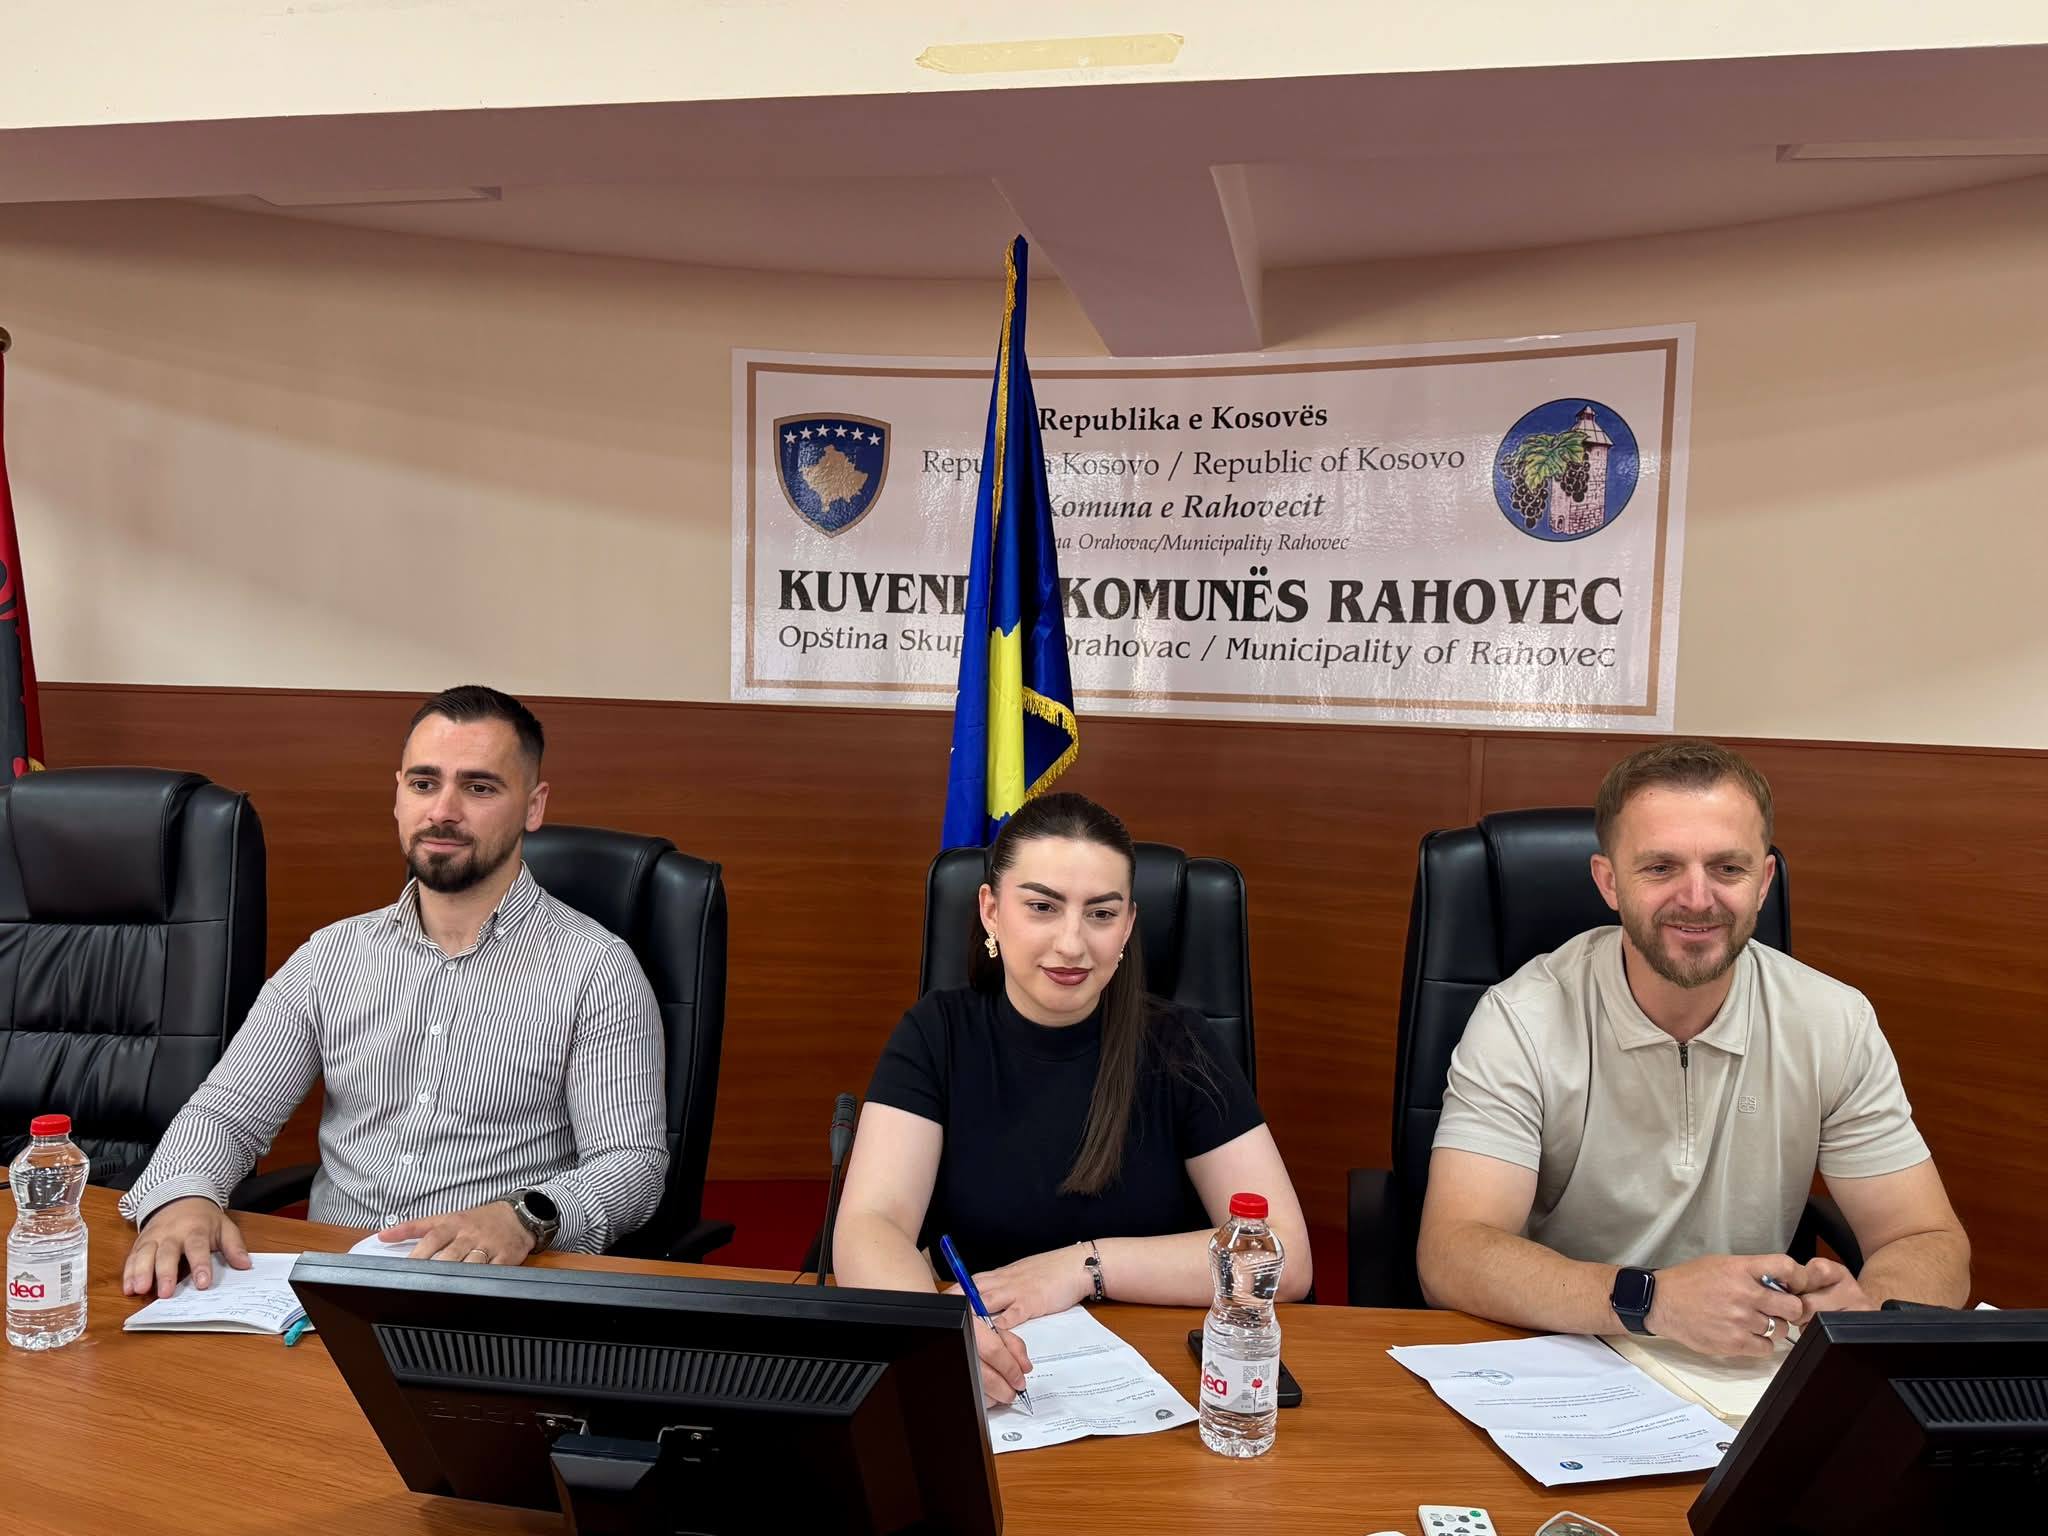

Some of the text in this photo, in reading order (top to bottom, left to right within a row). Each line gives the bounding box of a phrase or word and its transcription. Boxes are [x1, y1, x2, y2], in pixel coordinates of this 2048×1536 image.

[1039, 405, 1327, 438] Republika e Kosovës
[1062, 452, 1159, 475] Kosovo
[1168, 451, 1183, 482] /
[1193, 450, 1312, 482] Republic
[1320, 447, 1349, 473] of
[1357, 447, 1465, 471] Kosovo
[1161, 500, 1174, 518] e
[1182, 494, 1326, 518] Rahovecit
[1278, 534, 1350, 551] Rahovec
[779, 566, 1623, 625] KUVEN KOMUNËS RAHOVEC
[779, 625, 887, 653] Opština
[1200, 635, 1216, 661] /
[1226, 638, 1412, 670] Municipality
[1423, 640, 1460, 665] of
[1470, 641, 1615, 667] Rahovec
